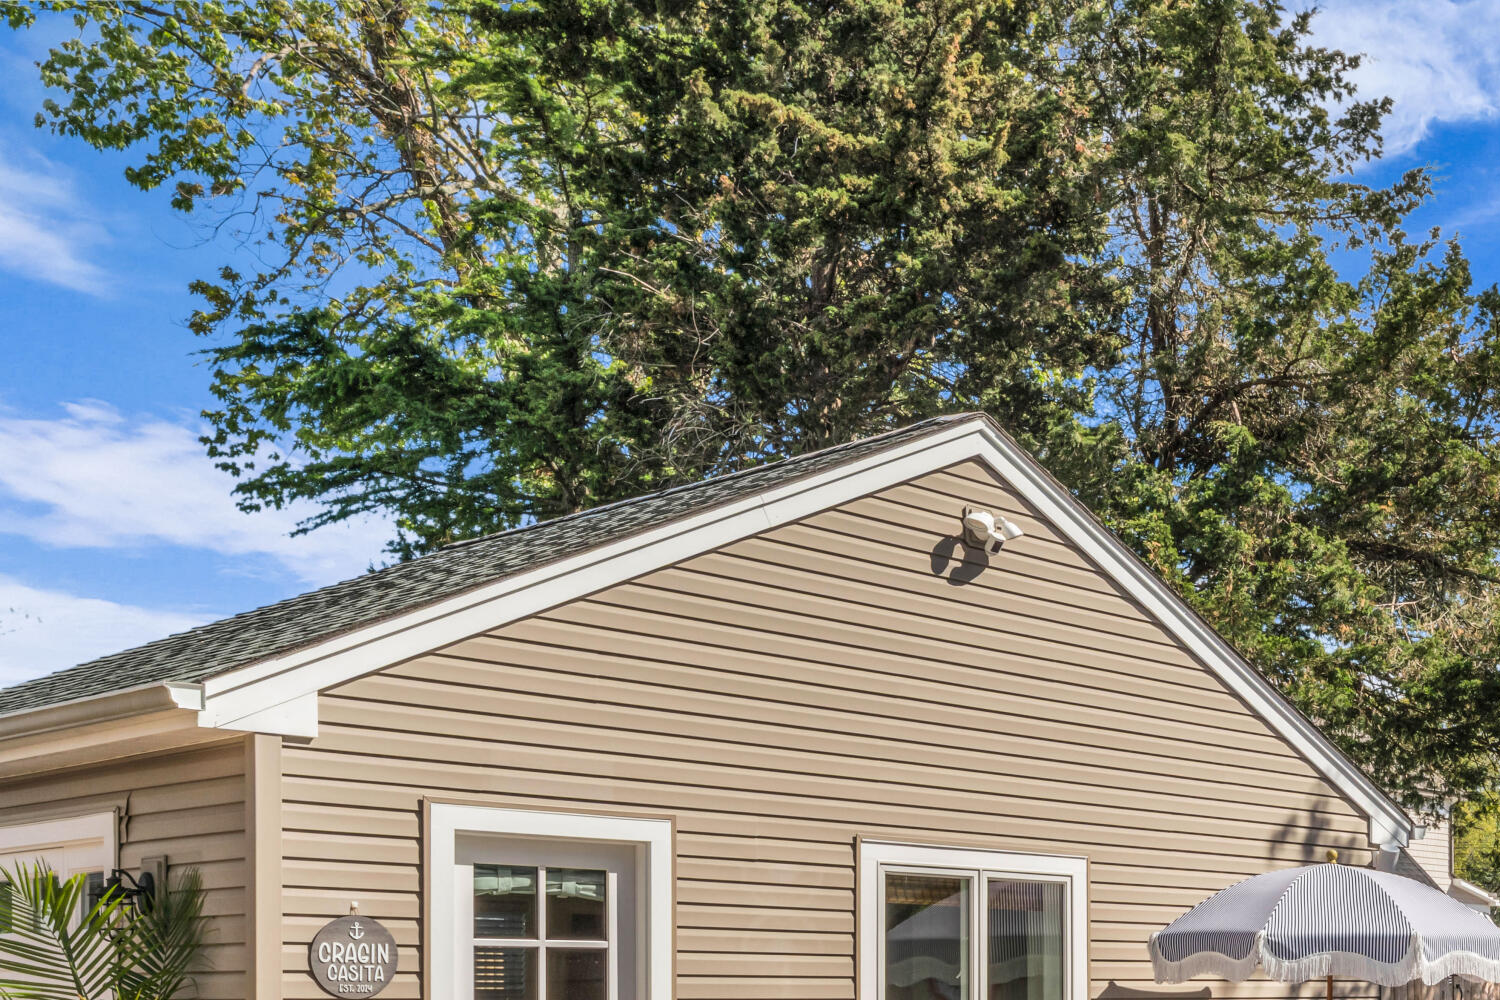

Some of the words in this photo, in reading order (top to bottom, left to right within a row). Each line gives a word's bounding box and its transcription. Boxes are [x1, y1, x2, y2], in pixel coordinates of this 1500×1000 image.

[318, 942, 389, 963] CRAGIN
[327, 964, 384, 981] CASITA
[339, 984, 355, 992] EST.
[357, 984, 373, 993] 2024
